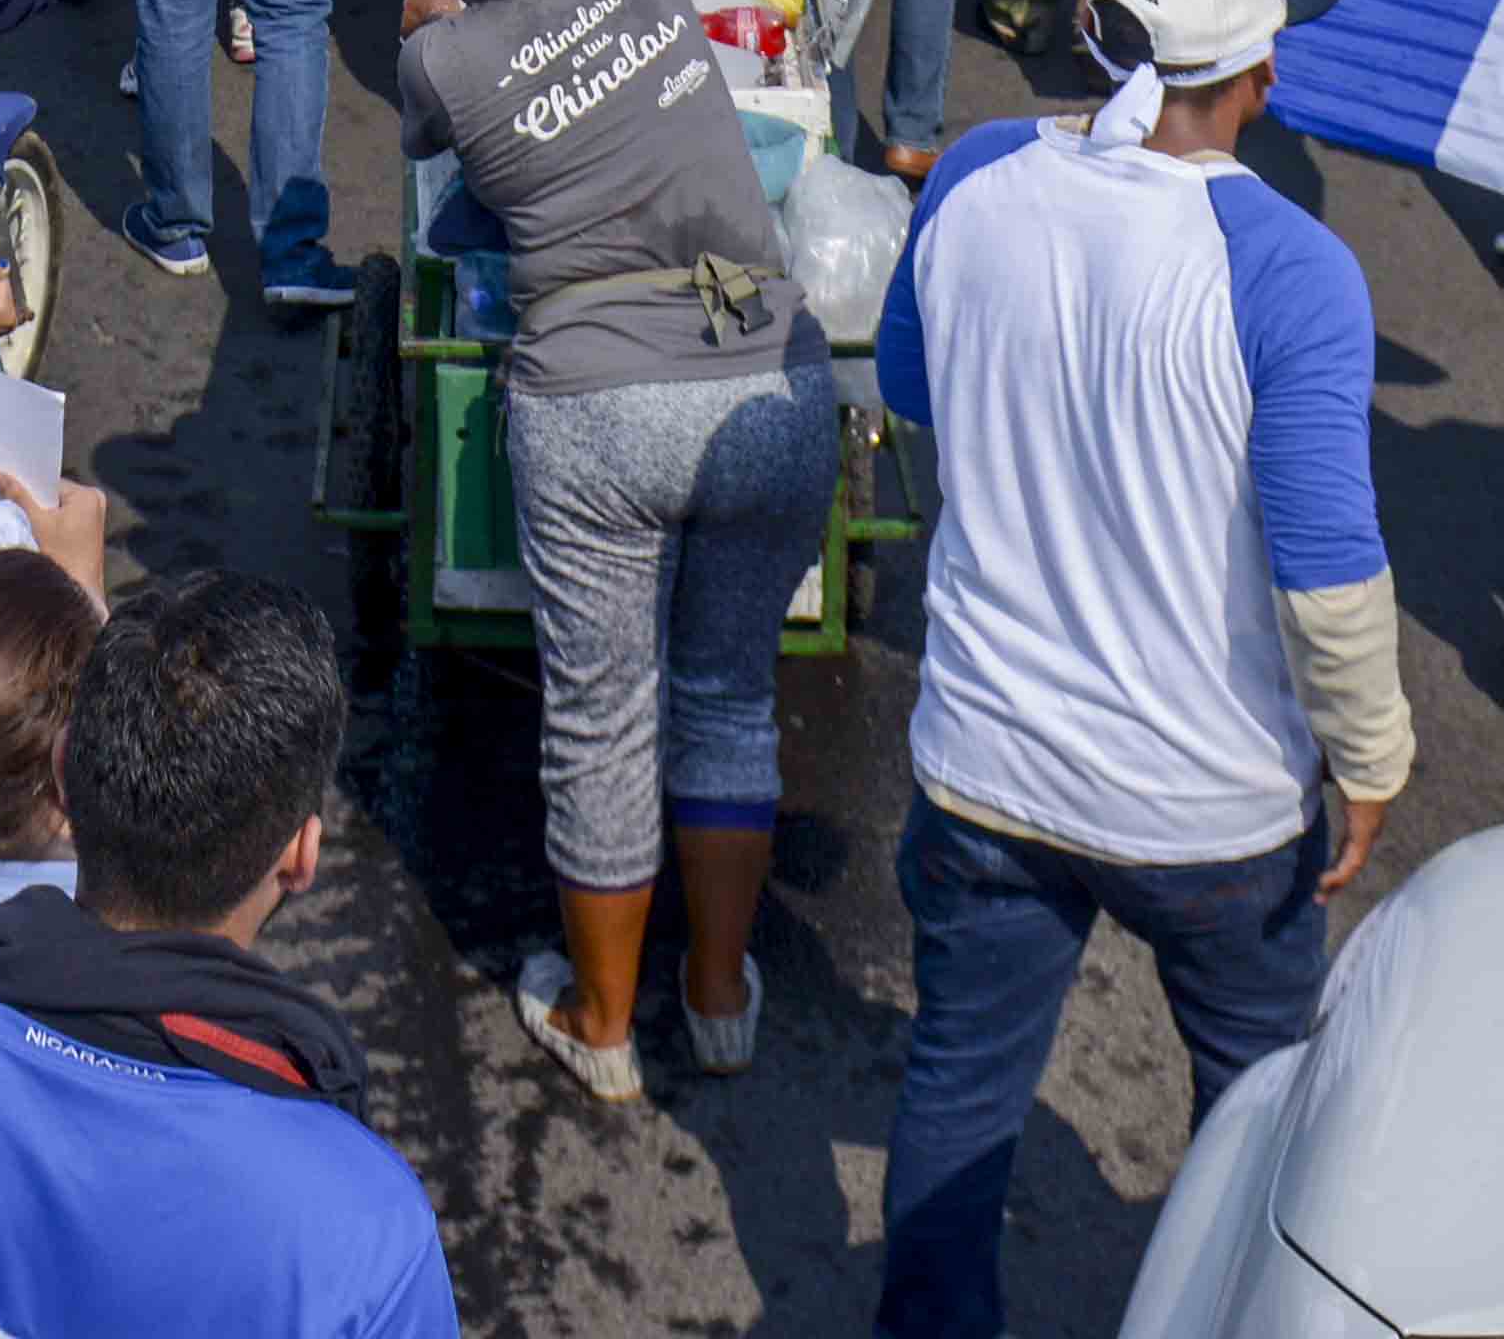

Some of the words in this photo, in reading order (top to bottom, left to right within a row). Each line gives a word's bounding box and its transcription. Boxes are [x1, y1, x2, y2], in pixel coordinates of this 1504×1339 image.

[513, 14, 688, 141] Chinelas
[571, 54, 586, 69] a
[583, 31, 613, 59] tus
